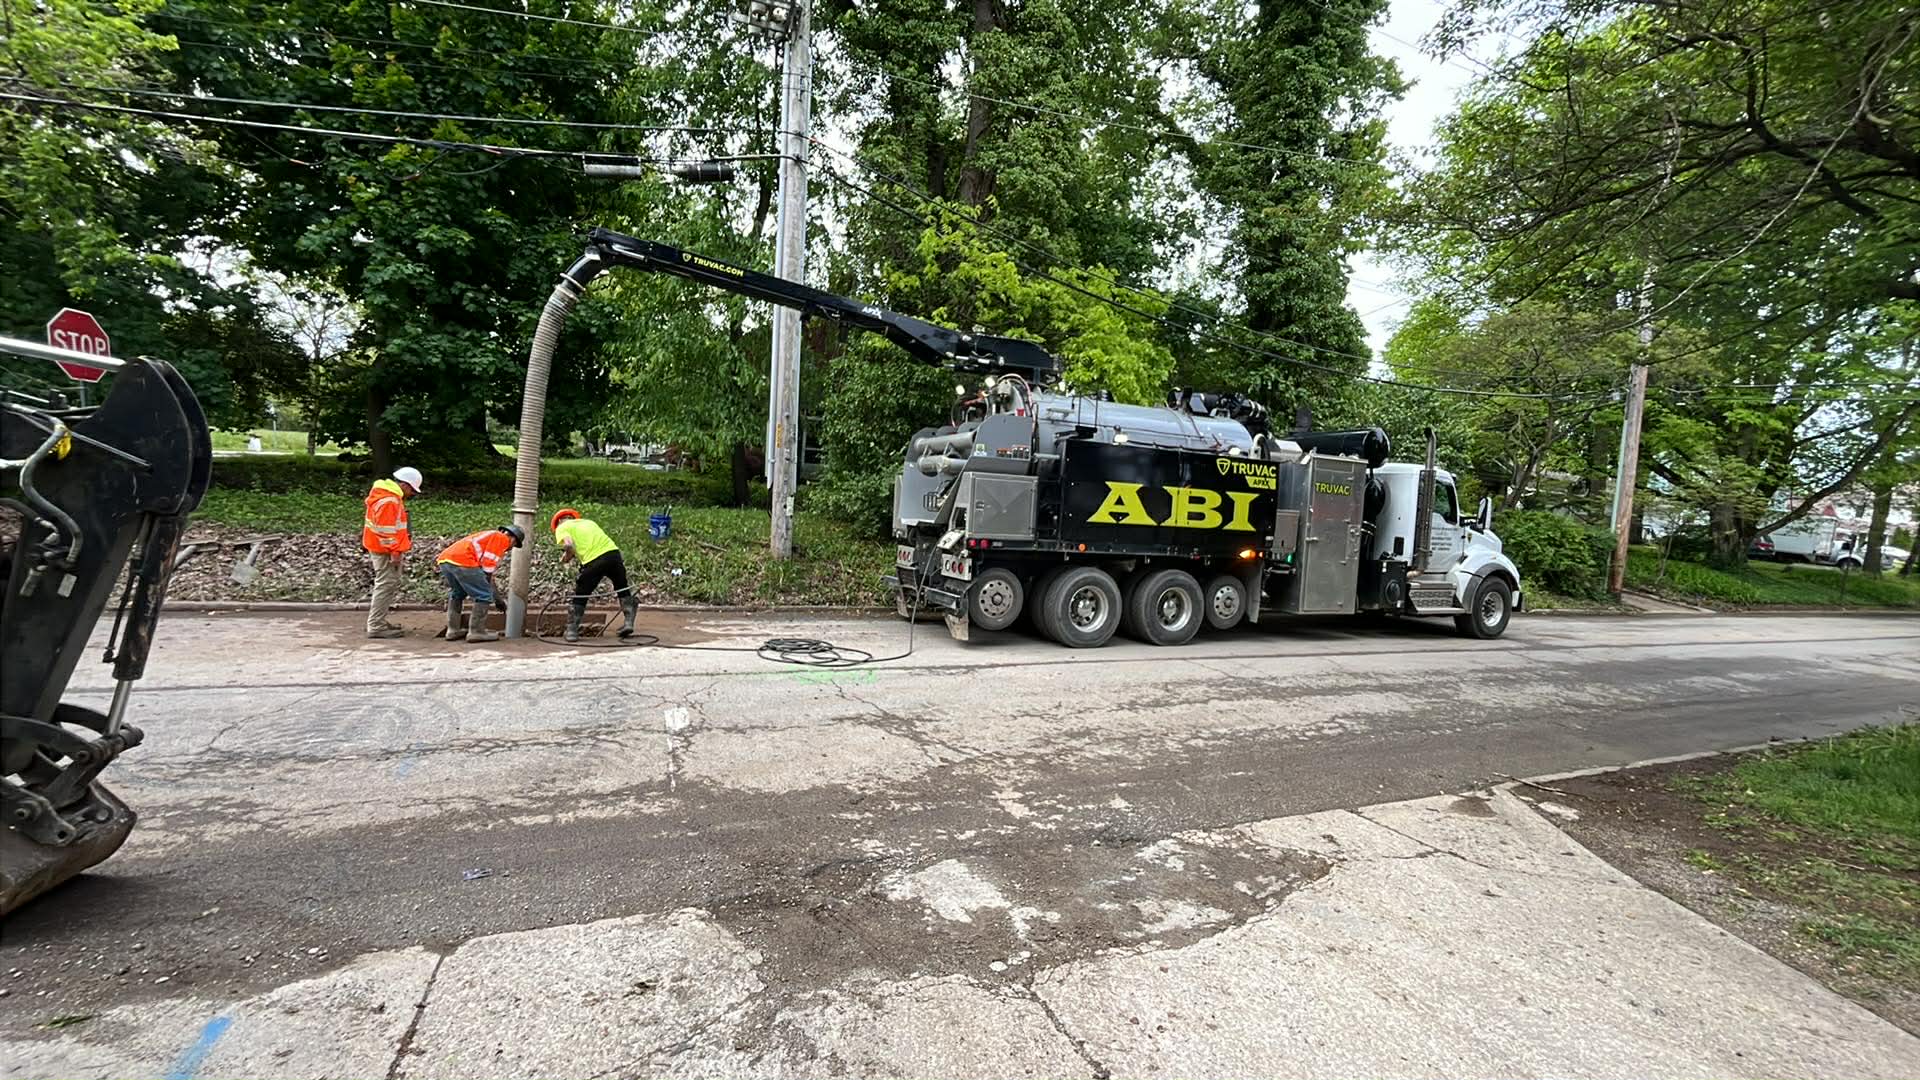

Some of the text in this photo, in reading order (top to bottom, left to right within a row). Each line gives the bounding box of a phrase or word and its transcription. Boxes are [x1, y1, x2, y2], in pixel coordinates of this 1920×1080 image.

[693, 256, 744, 277] TRUVAC.COM
[53, 328, 106, 356] STOP
[1231, 462, 1277, 477] TRUVAC
[1315, 482, 1351, 496] TRUVAC
[1086, 481, 1260, 532] ABI
